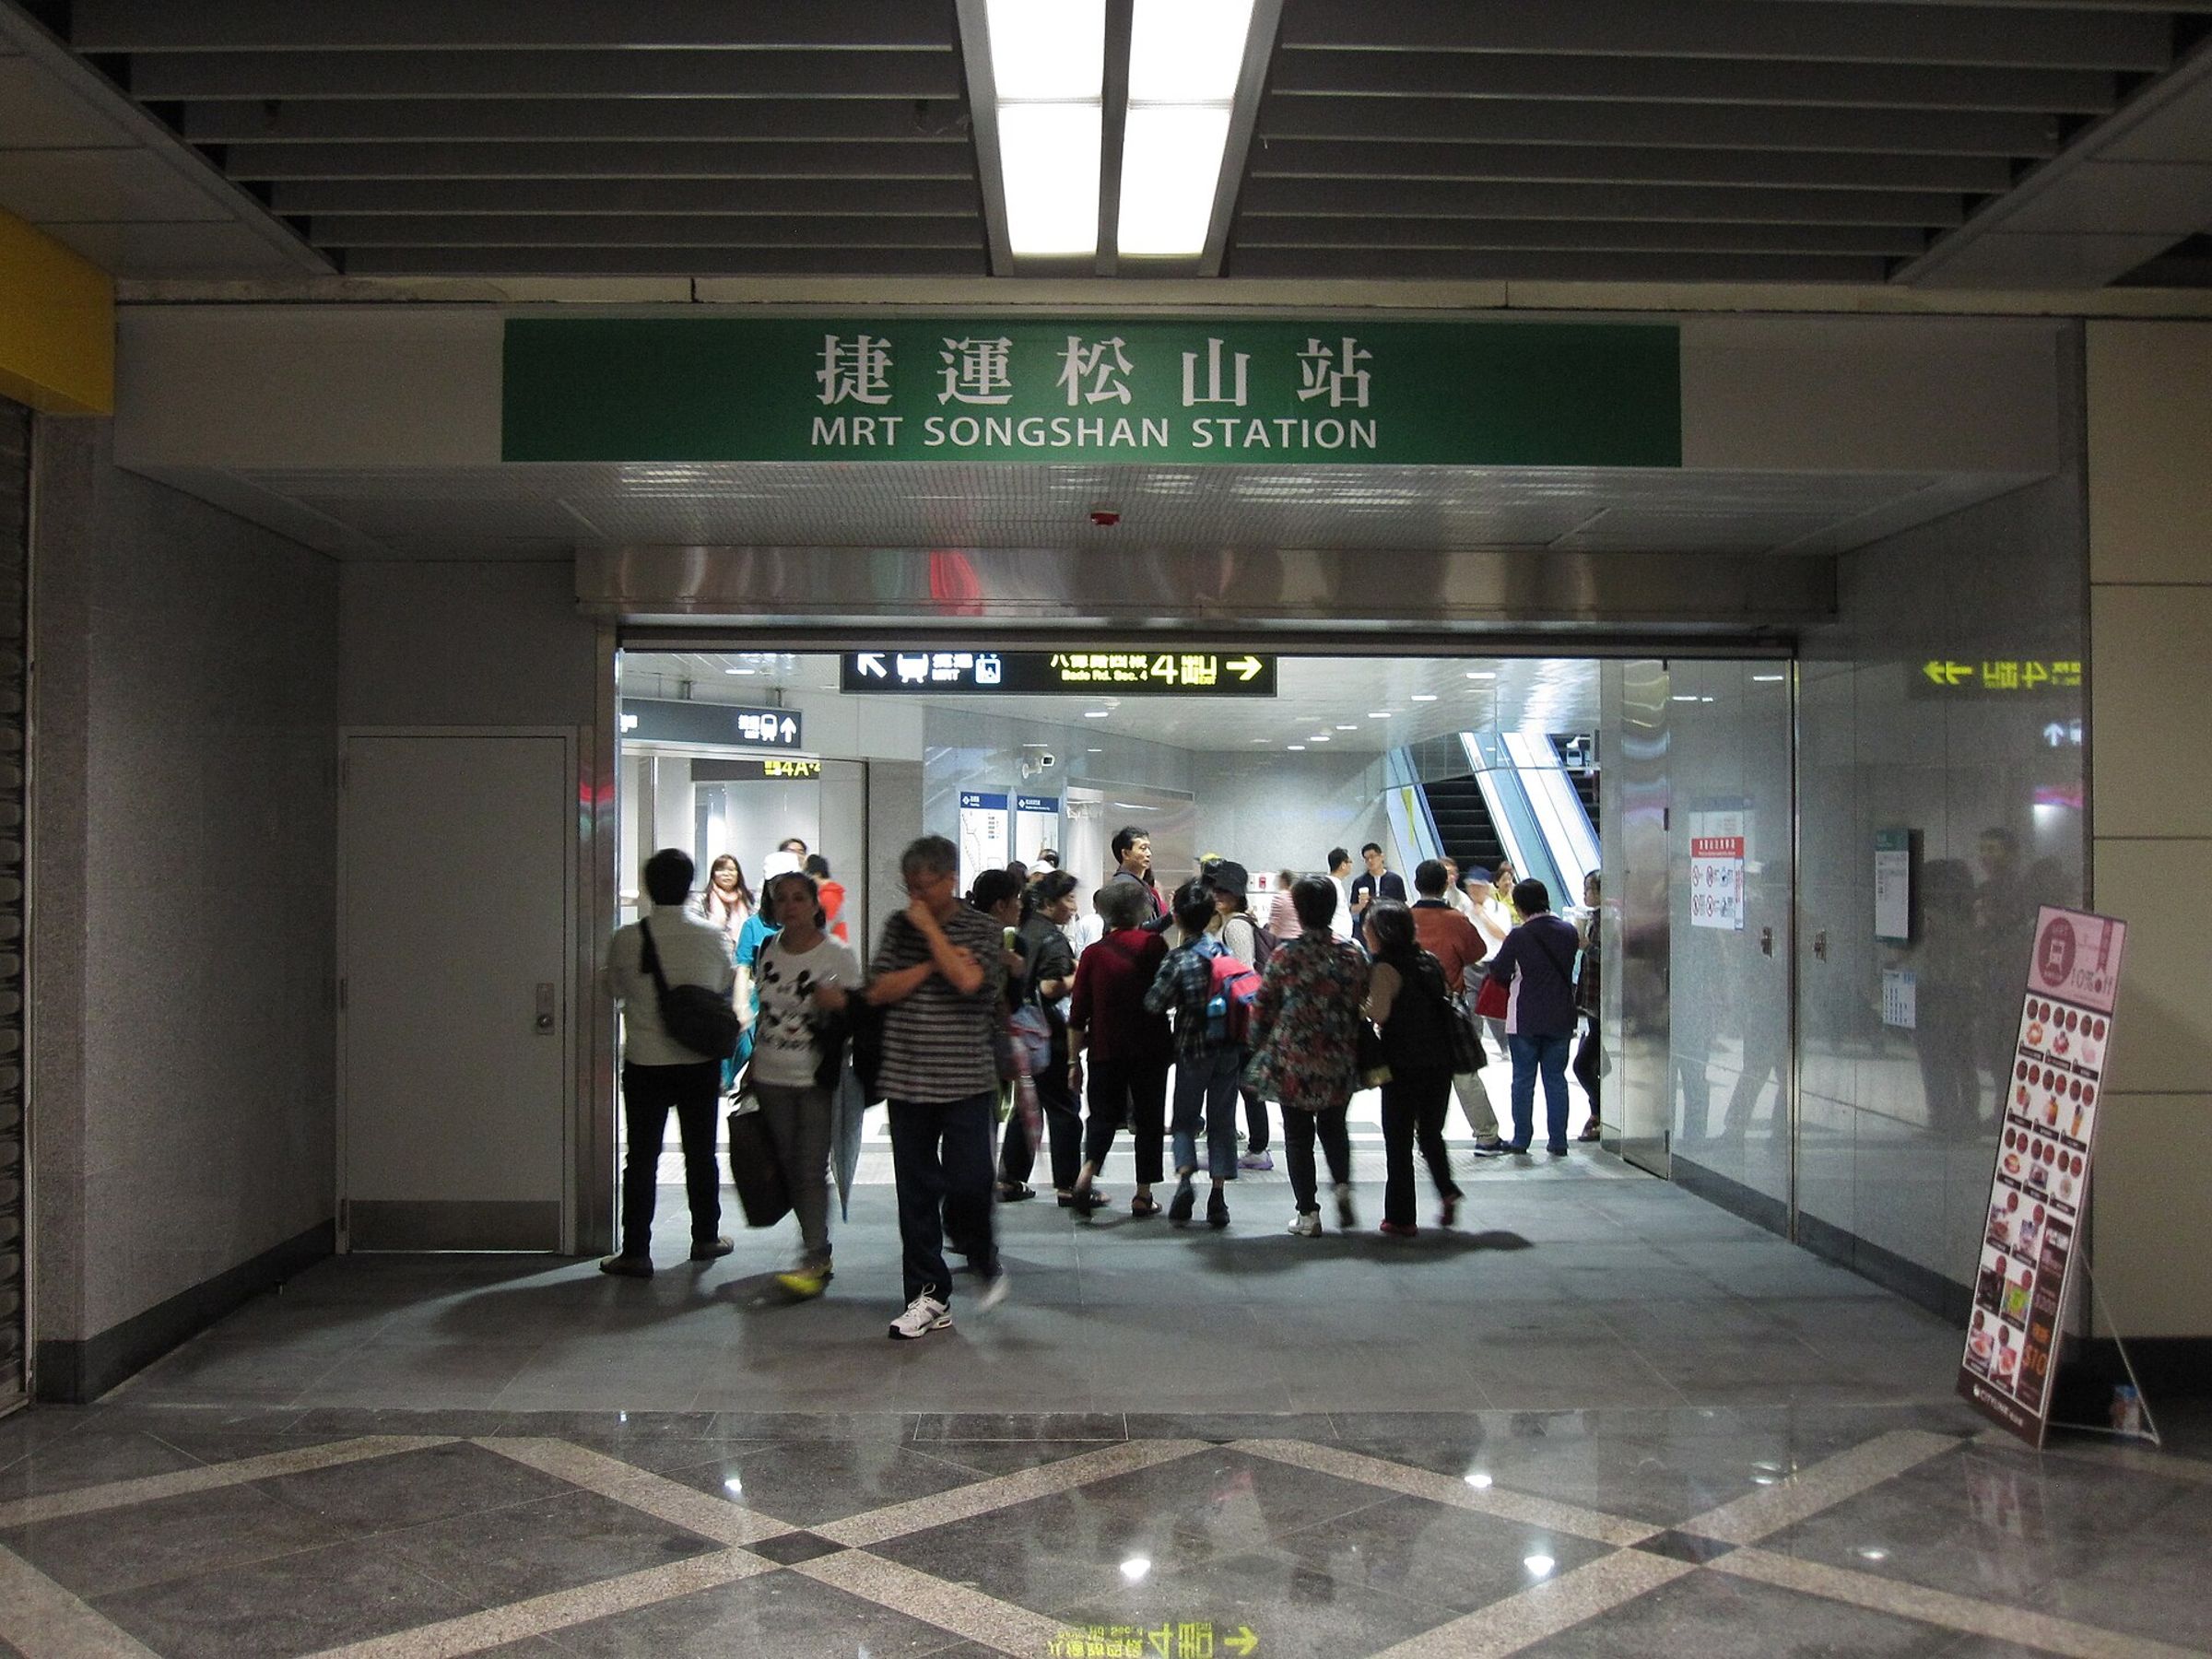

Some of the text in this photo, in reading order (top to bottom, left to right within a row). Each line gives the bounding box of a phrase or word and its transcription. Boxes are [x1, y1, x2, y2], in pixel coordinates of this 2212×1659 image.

[816, 335, 1372, 408] 捷運松山站
[811, 416, 1376, 449] MRT SONGSHAN STATION
[1150, 654, 1180, 685] 4
